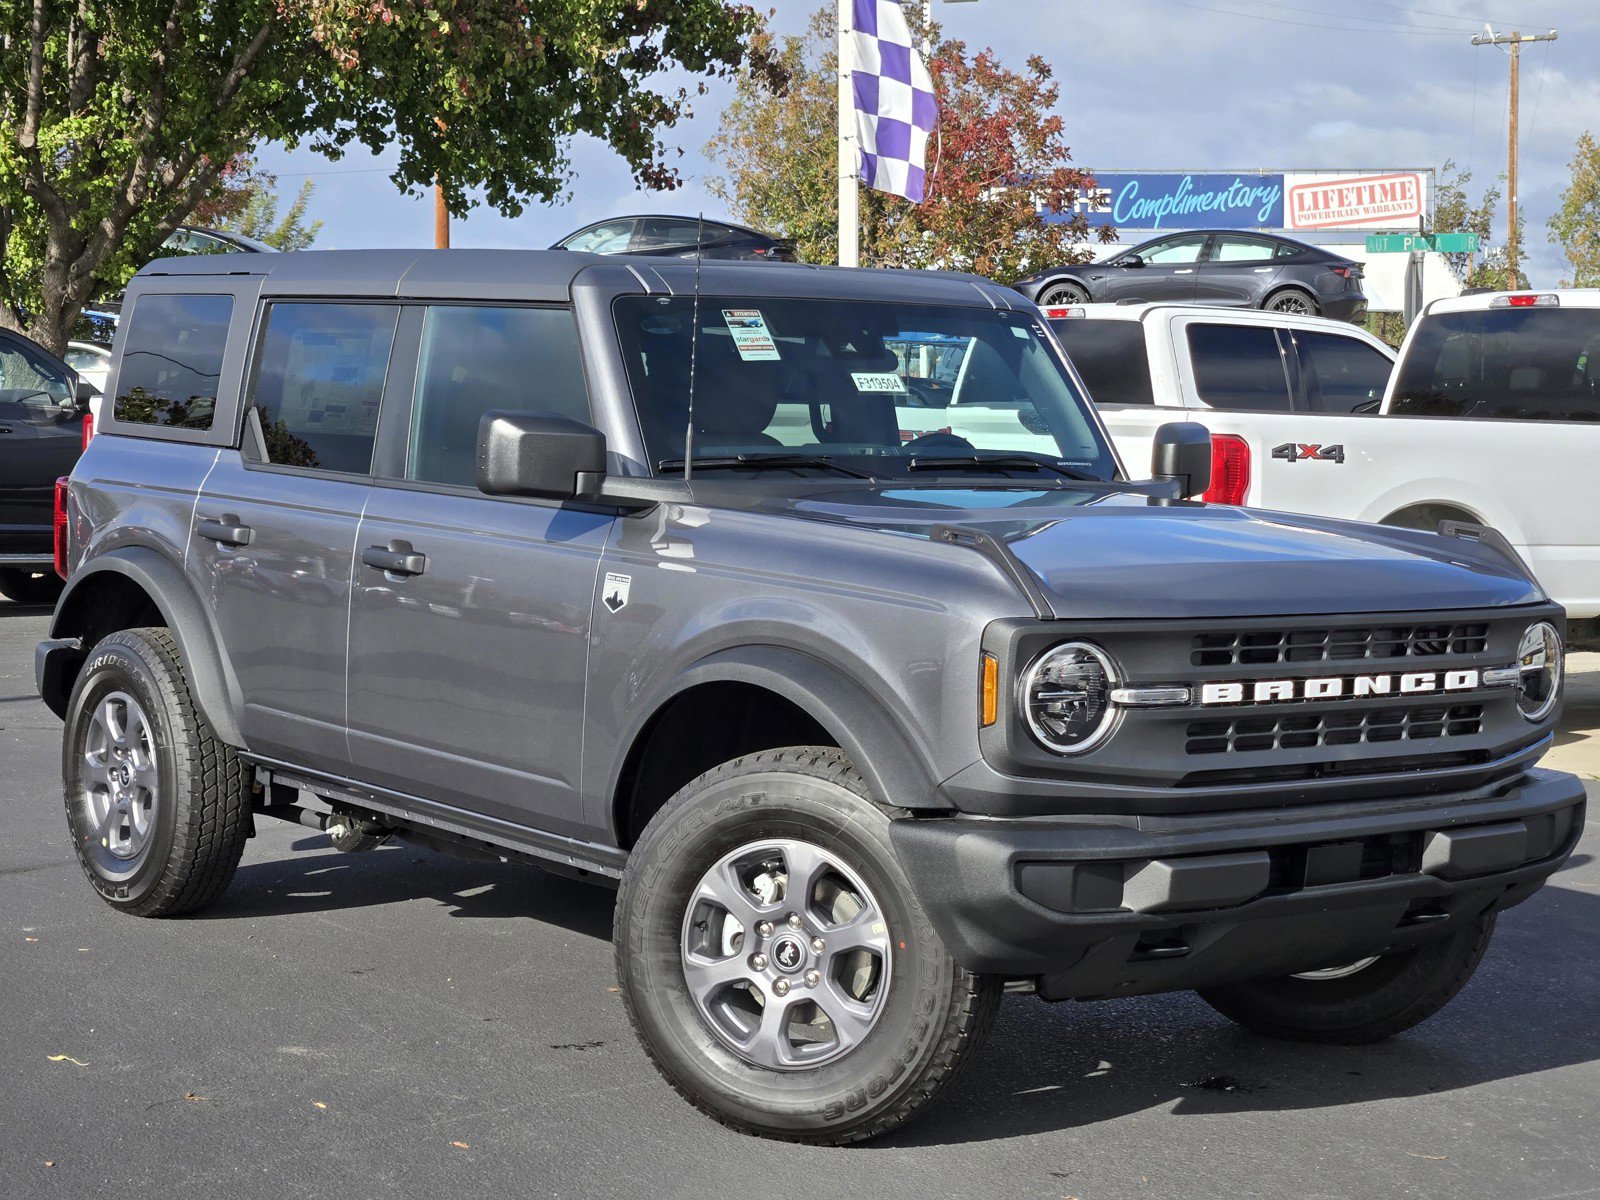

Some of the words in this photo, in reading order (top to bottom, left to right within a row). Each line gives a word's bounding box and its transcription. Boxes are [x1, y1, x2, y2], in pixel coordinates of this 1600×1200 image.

[1113, 175, 1281, 230] Complimentary
[1296, 180, 1415, 212] LIFETIME
[1298, 207, 1360, 222] POWERTRAIN
[1362, 201, 1415, 215] WARRANTY
[857, 377, 901, 390] F319504
[1201, 669, 1479, 704] BRONCO
